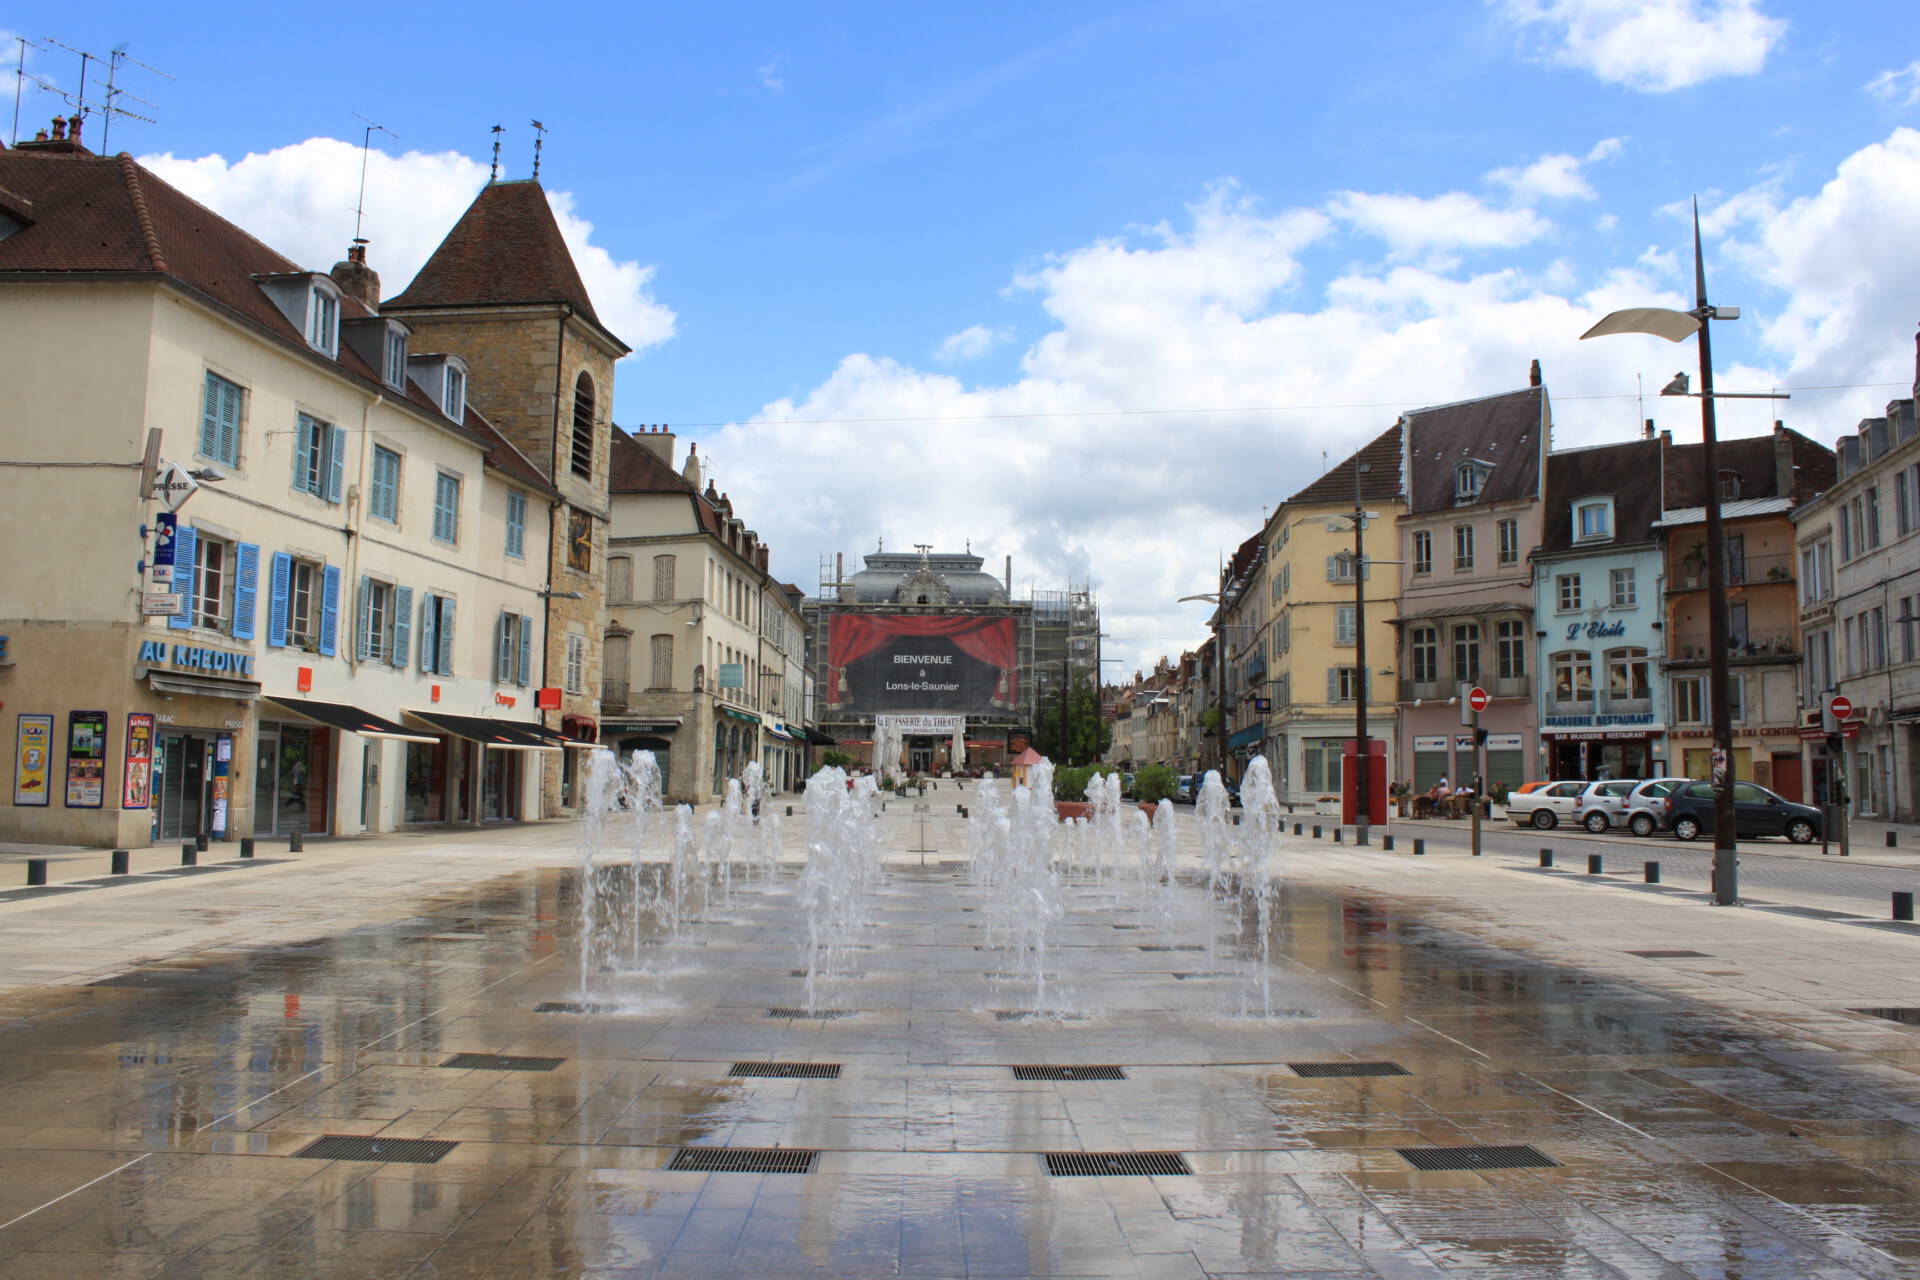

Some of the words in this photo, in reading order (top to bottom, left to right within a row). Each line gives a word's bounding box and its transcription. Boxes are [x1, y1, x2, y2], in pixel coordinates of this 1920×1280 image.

[153, 482, 188, 490] PRESSE
[1566, 620, 1625, 640] L'Etoile
[140, 640, 166, 663] AU
[172, 644, 255, 675] KHEDIVE
[893, 655, 953, 664] BIENVENUE
[919, 668, 926, 678] à
[886, 681, 960, 691] Lons-le-Saunier
[156, 714, 175, 723] TABAC
[1546, 716, 1592, 726] BRASSERIE
[1596, 714, 1655, 724] RESTAURANT
[224, 720, 245, 729] PRESSE
[1743, 728, 1757, 737] DU
